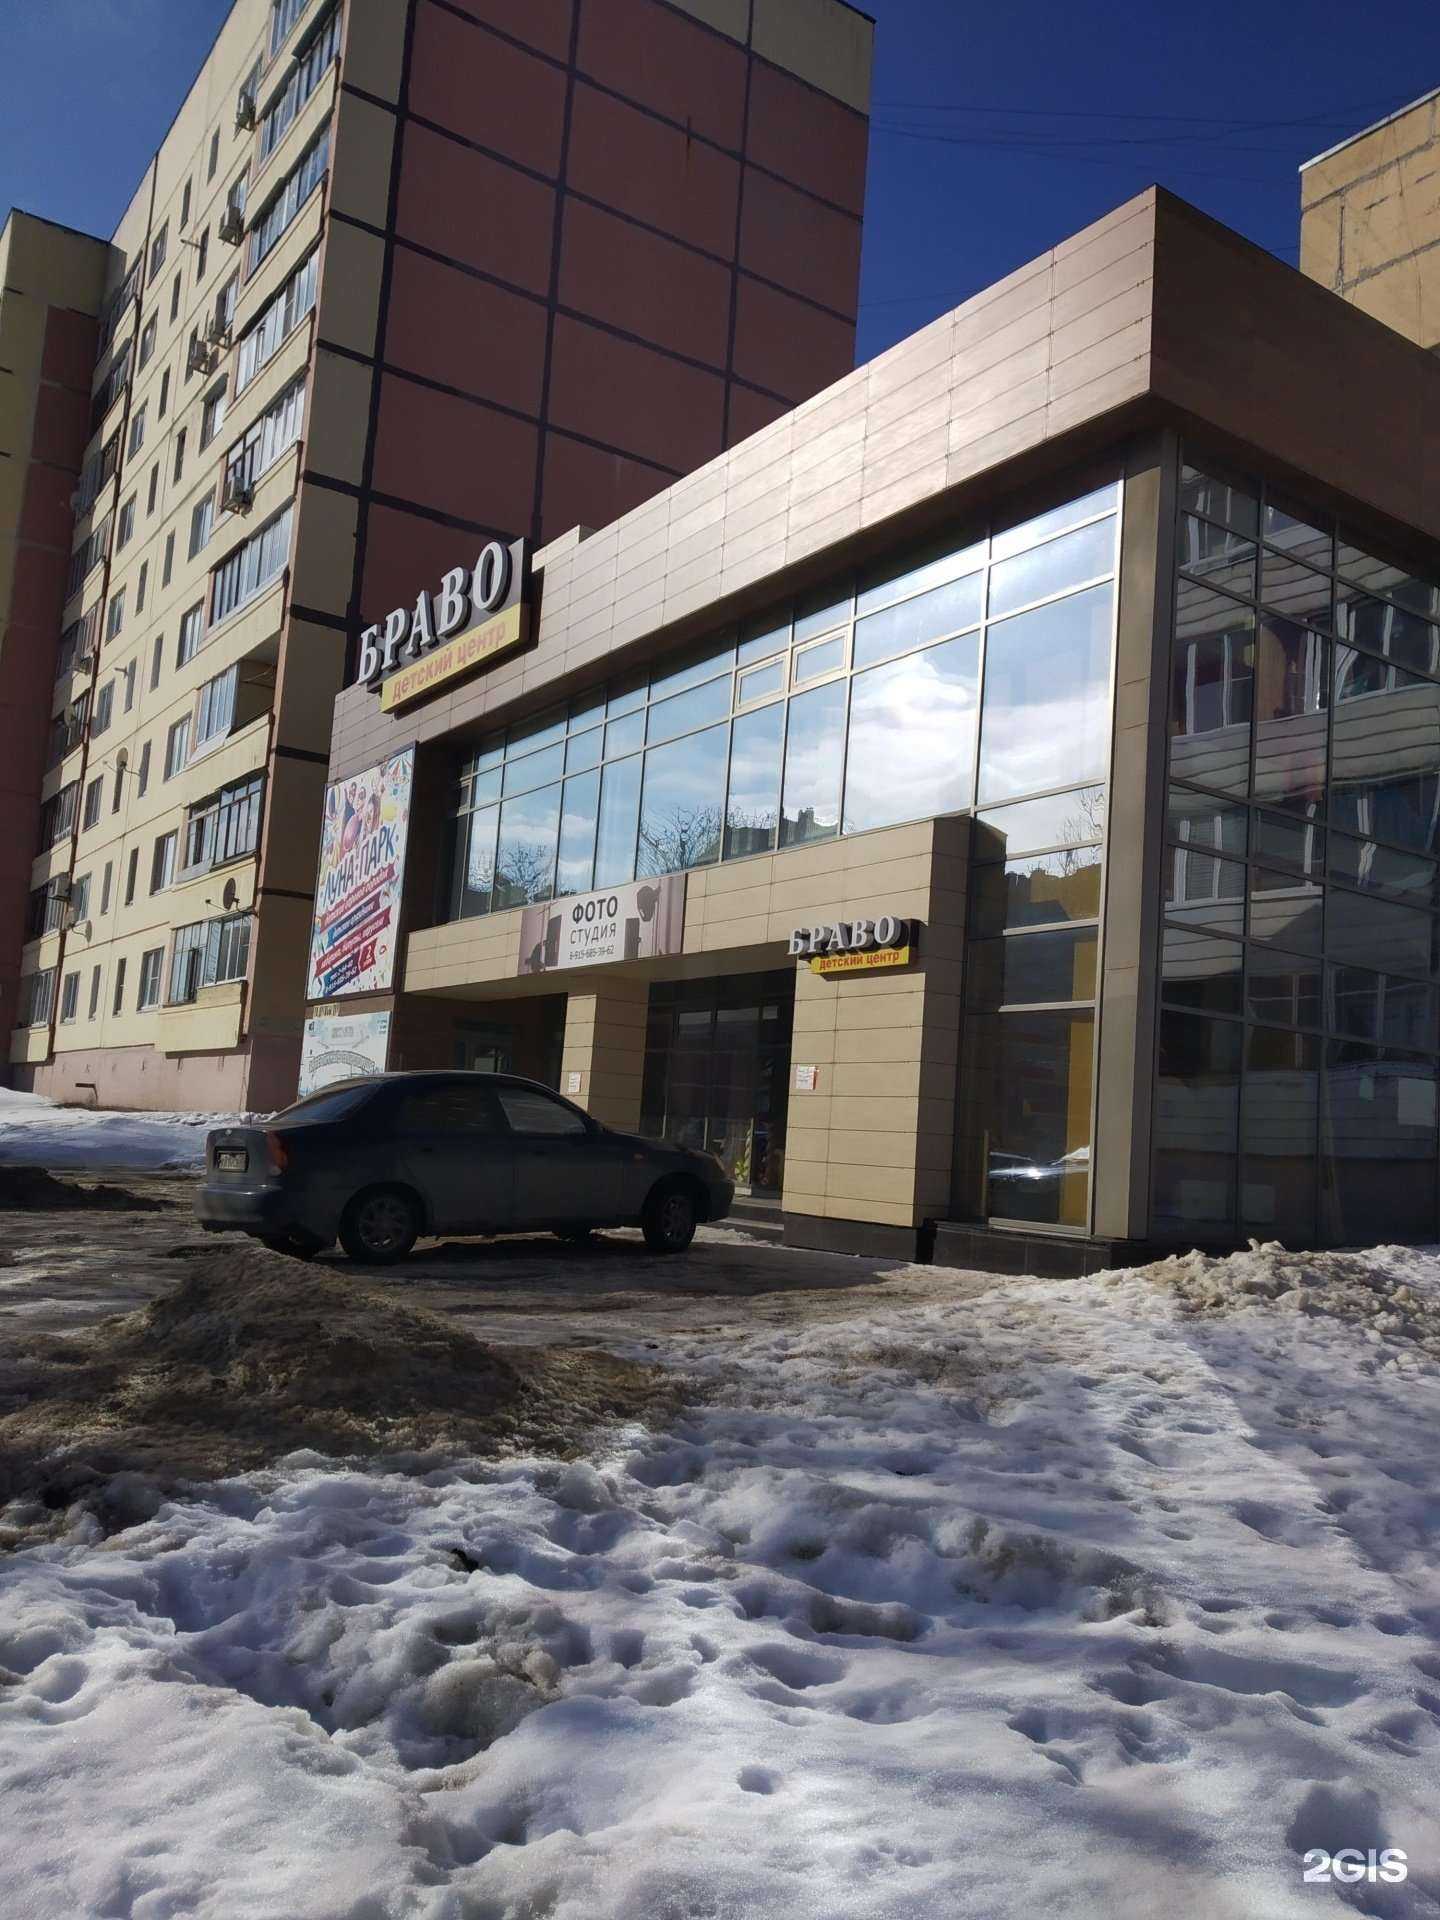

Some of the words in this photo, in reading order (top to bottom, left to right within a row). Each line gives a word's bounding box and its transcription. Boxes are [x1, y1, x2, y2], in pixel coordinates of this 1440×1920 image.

[357, 541, 508, 685] БРАВО
[392, 647, 453, 702] детский
[458, 621, 506, 666] центр
[572, 896, 618, 924] ФОТО
[570, 922, 617, 946] СТУДИЯ
[787, 916, 897, 955] БРАВО
[819, 953, 863, 971] детский
[866, 951, 900, 966] центр
